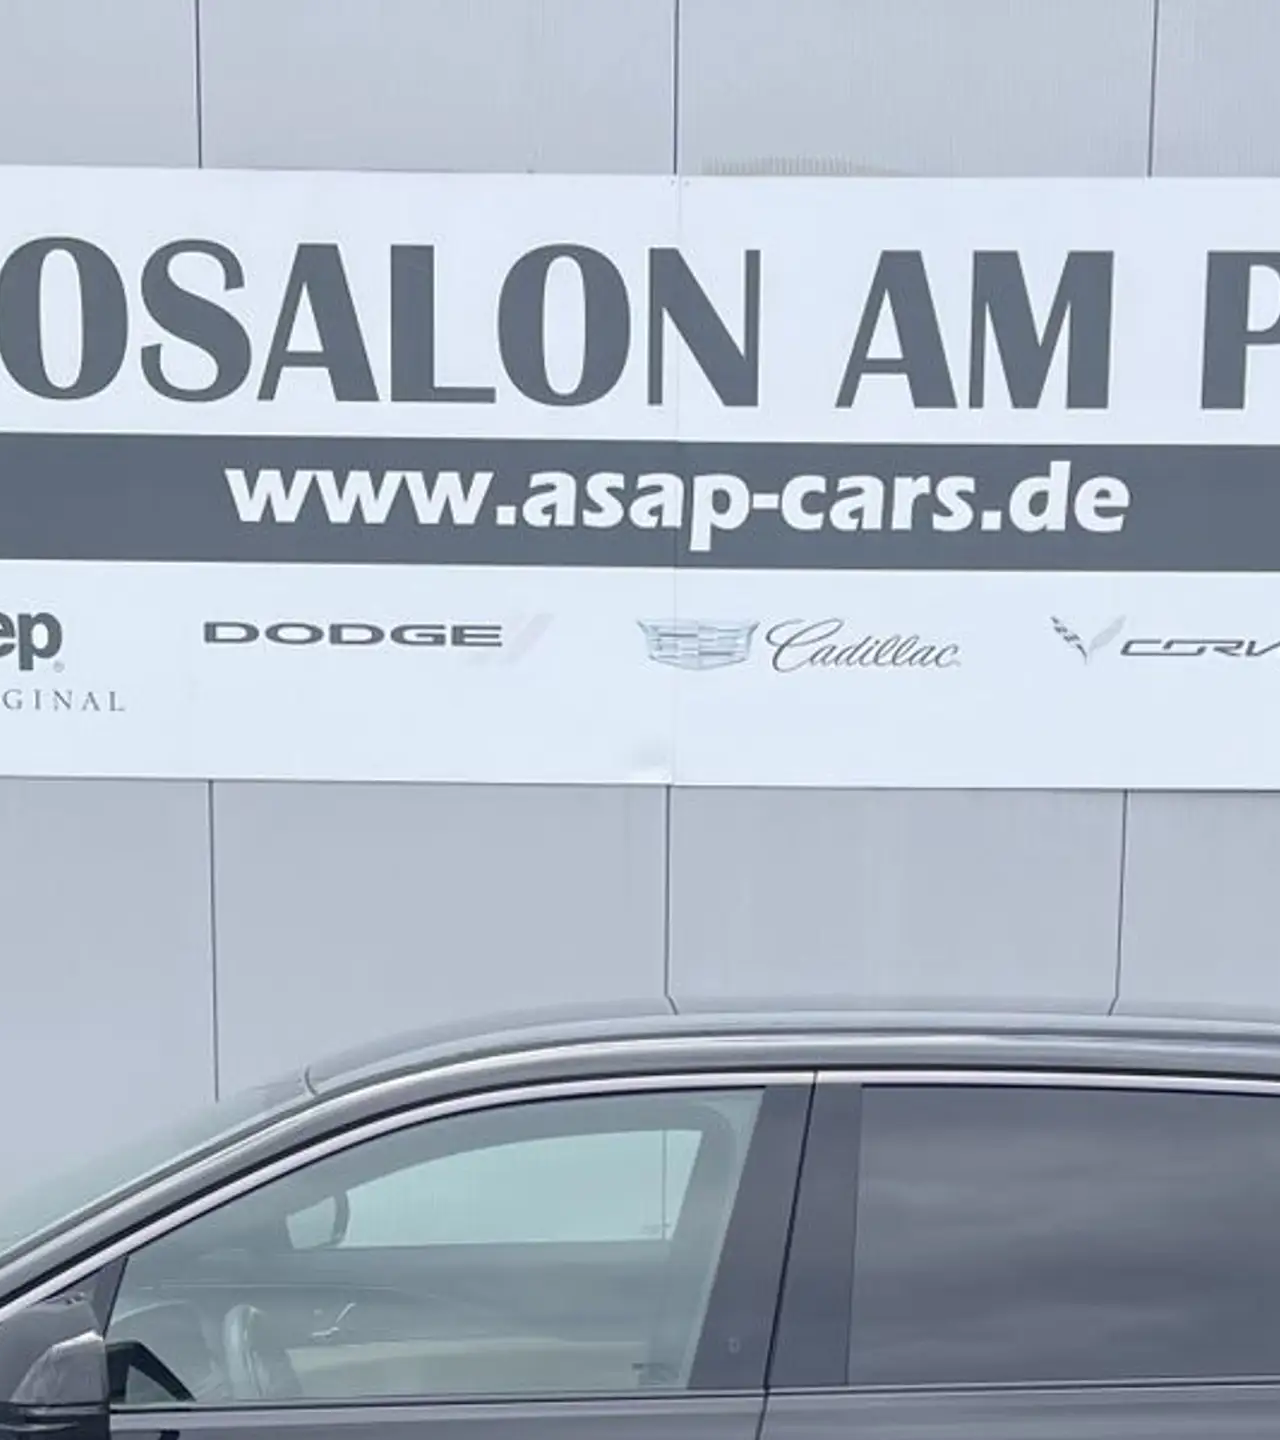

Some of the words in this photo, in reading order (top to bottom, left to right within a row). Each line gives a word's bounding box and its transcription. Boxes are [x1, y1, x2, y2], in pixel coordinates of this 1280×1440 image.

[834, 249, 1115, 410] AM
[224, 460, 1131, 552] www.asap-cars.de
[202, 620, 504, 648] DODGE
[764, 617, 961, 674] Cadillac
